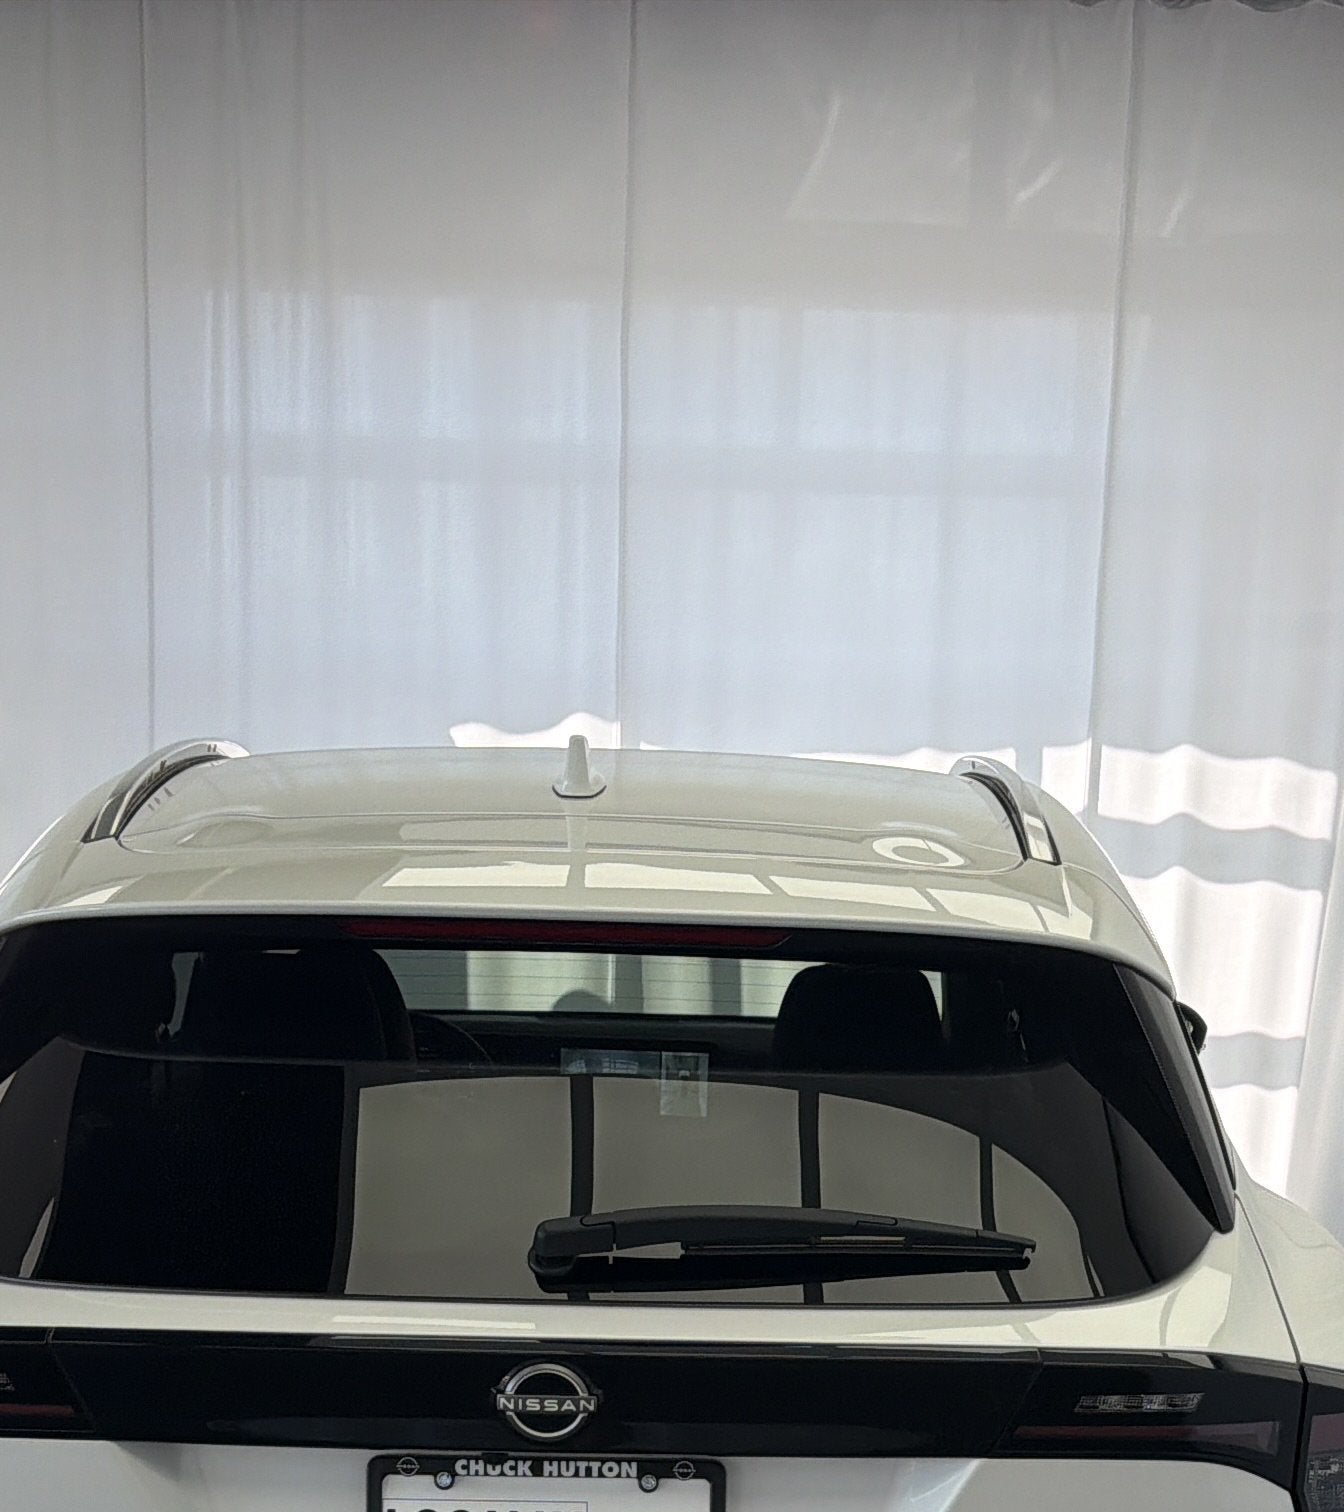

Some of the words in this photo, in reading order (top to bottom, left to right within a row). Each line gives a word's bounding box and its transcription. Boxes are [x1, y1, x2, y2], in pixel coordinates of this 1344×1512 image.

[498, 1397, 596, 1412] NISSAN
[454, 1458, 533, 1477] CHUCK
[542, 1460, 638, 1478] HUTTON
